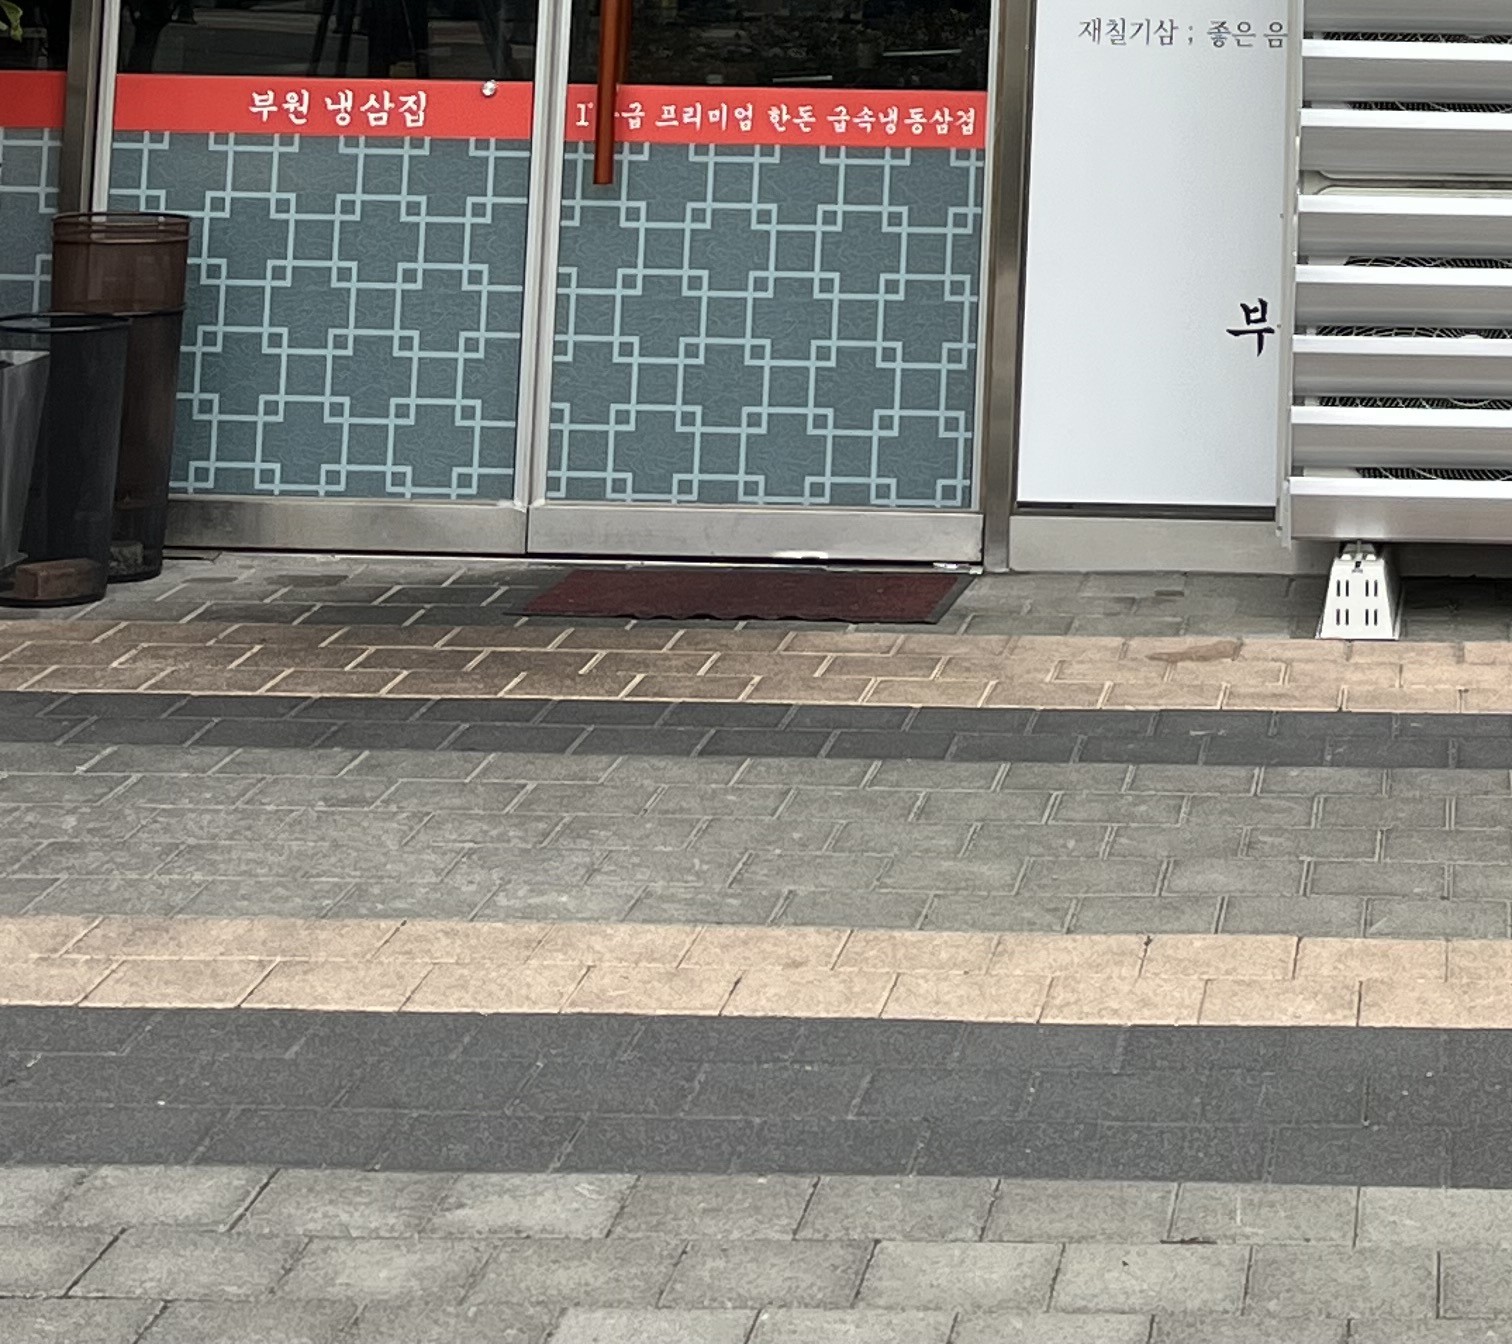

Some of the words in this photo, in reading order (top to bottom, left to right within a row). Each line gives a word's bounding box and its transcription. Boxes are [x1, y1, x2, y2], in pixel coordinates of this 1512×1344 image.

[1078, 17, 1179, 47] 재칠기삼
[1206, 20, 1257, 49] 좋은
[249, 89, 310, 125] 부원
[325, 89, 428, 127] 냉삼집
[654, 102, 755, 132] 프리미엄
[767, 103, 817, 133] 한돈
[826, 104, 977, 136] 급속냉동삼겹
